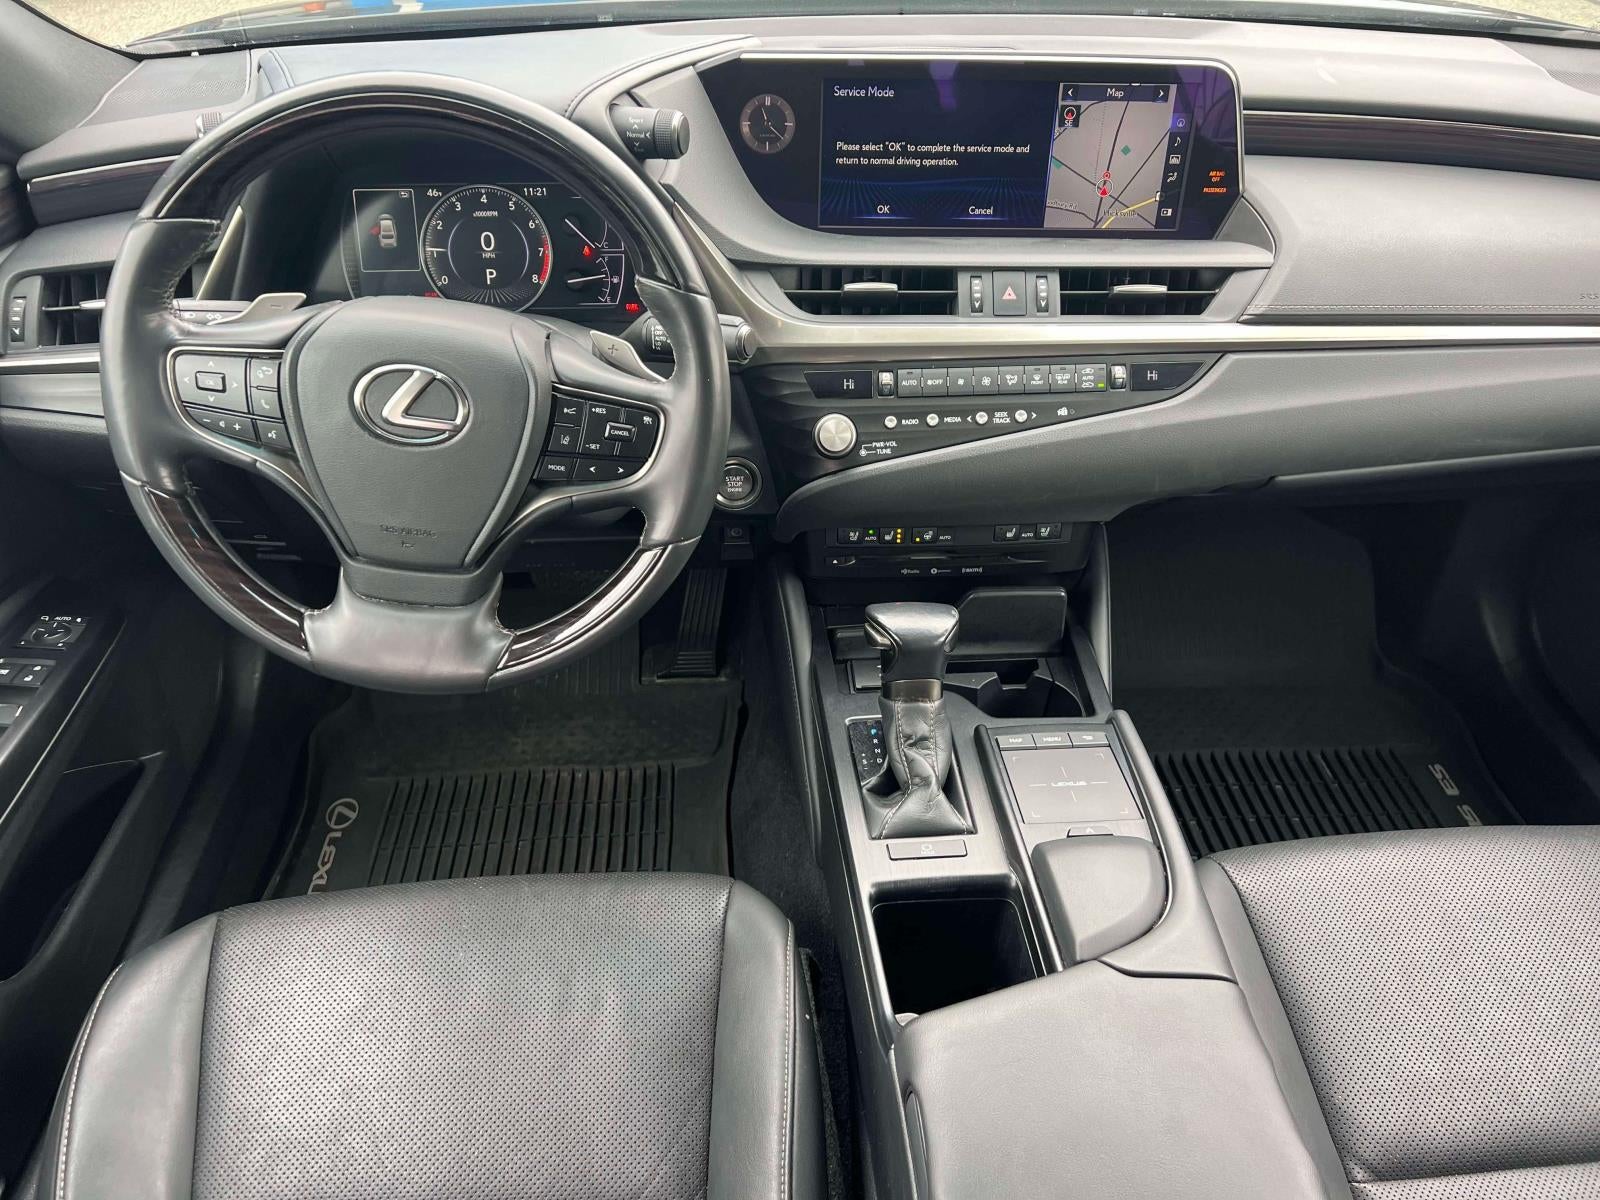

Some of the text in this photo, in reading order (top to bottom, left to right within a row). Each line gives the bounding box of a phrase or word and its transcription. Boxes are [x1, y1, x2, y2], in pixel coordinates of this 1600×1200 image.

[834, 86, 894, 97] Service Mode
[1106, 88, 1124, 98] Map
[836, 142, 860, 150] Please
[862, 142, 883, 151] select
[886, 142, 905, 151] "OK"
[917, 143, 950, 154] complete
[953, 144, 966, 152] the
[967, 144, 992, 152] service
[994, 144, 1014, 152] mode
[1016, 144, 1030, 152] and
[836, 157, 858, 165] return
[870, 157, 895, 165] normal
[897, 157, 920, 167] driving
[922, 158, 958, 167] operation.
[524, 188, 546, 196] 11:21
[480, 194, 488, 203] 4
[455, 202, 461, 210] 3
[508, 202, 514, 210] 5
[877, 205, 890, 214] OK
[968, 206, 993, 214] Cancel
[436, 220, 442, 230] 2
[529, 220, 536, 228] 6
[480, 232, 494, 250] 0
[538, 248, 544, 256] 7
[442, 276, 448, 284] 0
[486, 269, 496, 284] P
[532, 274, 539, 283] 8
[1148, 370, 1158, 380] Hi
[844, 378, 854, 390] Hi
[308, 832, 342, 894] LEXU
